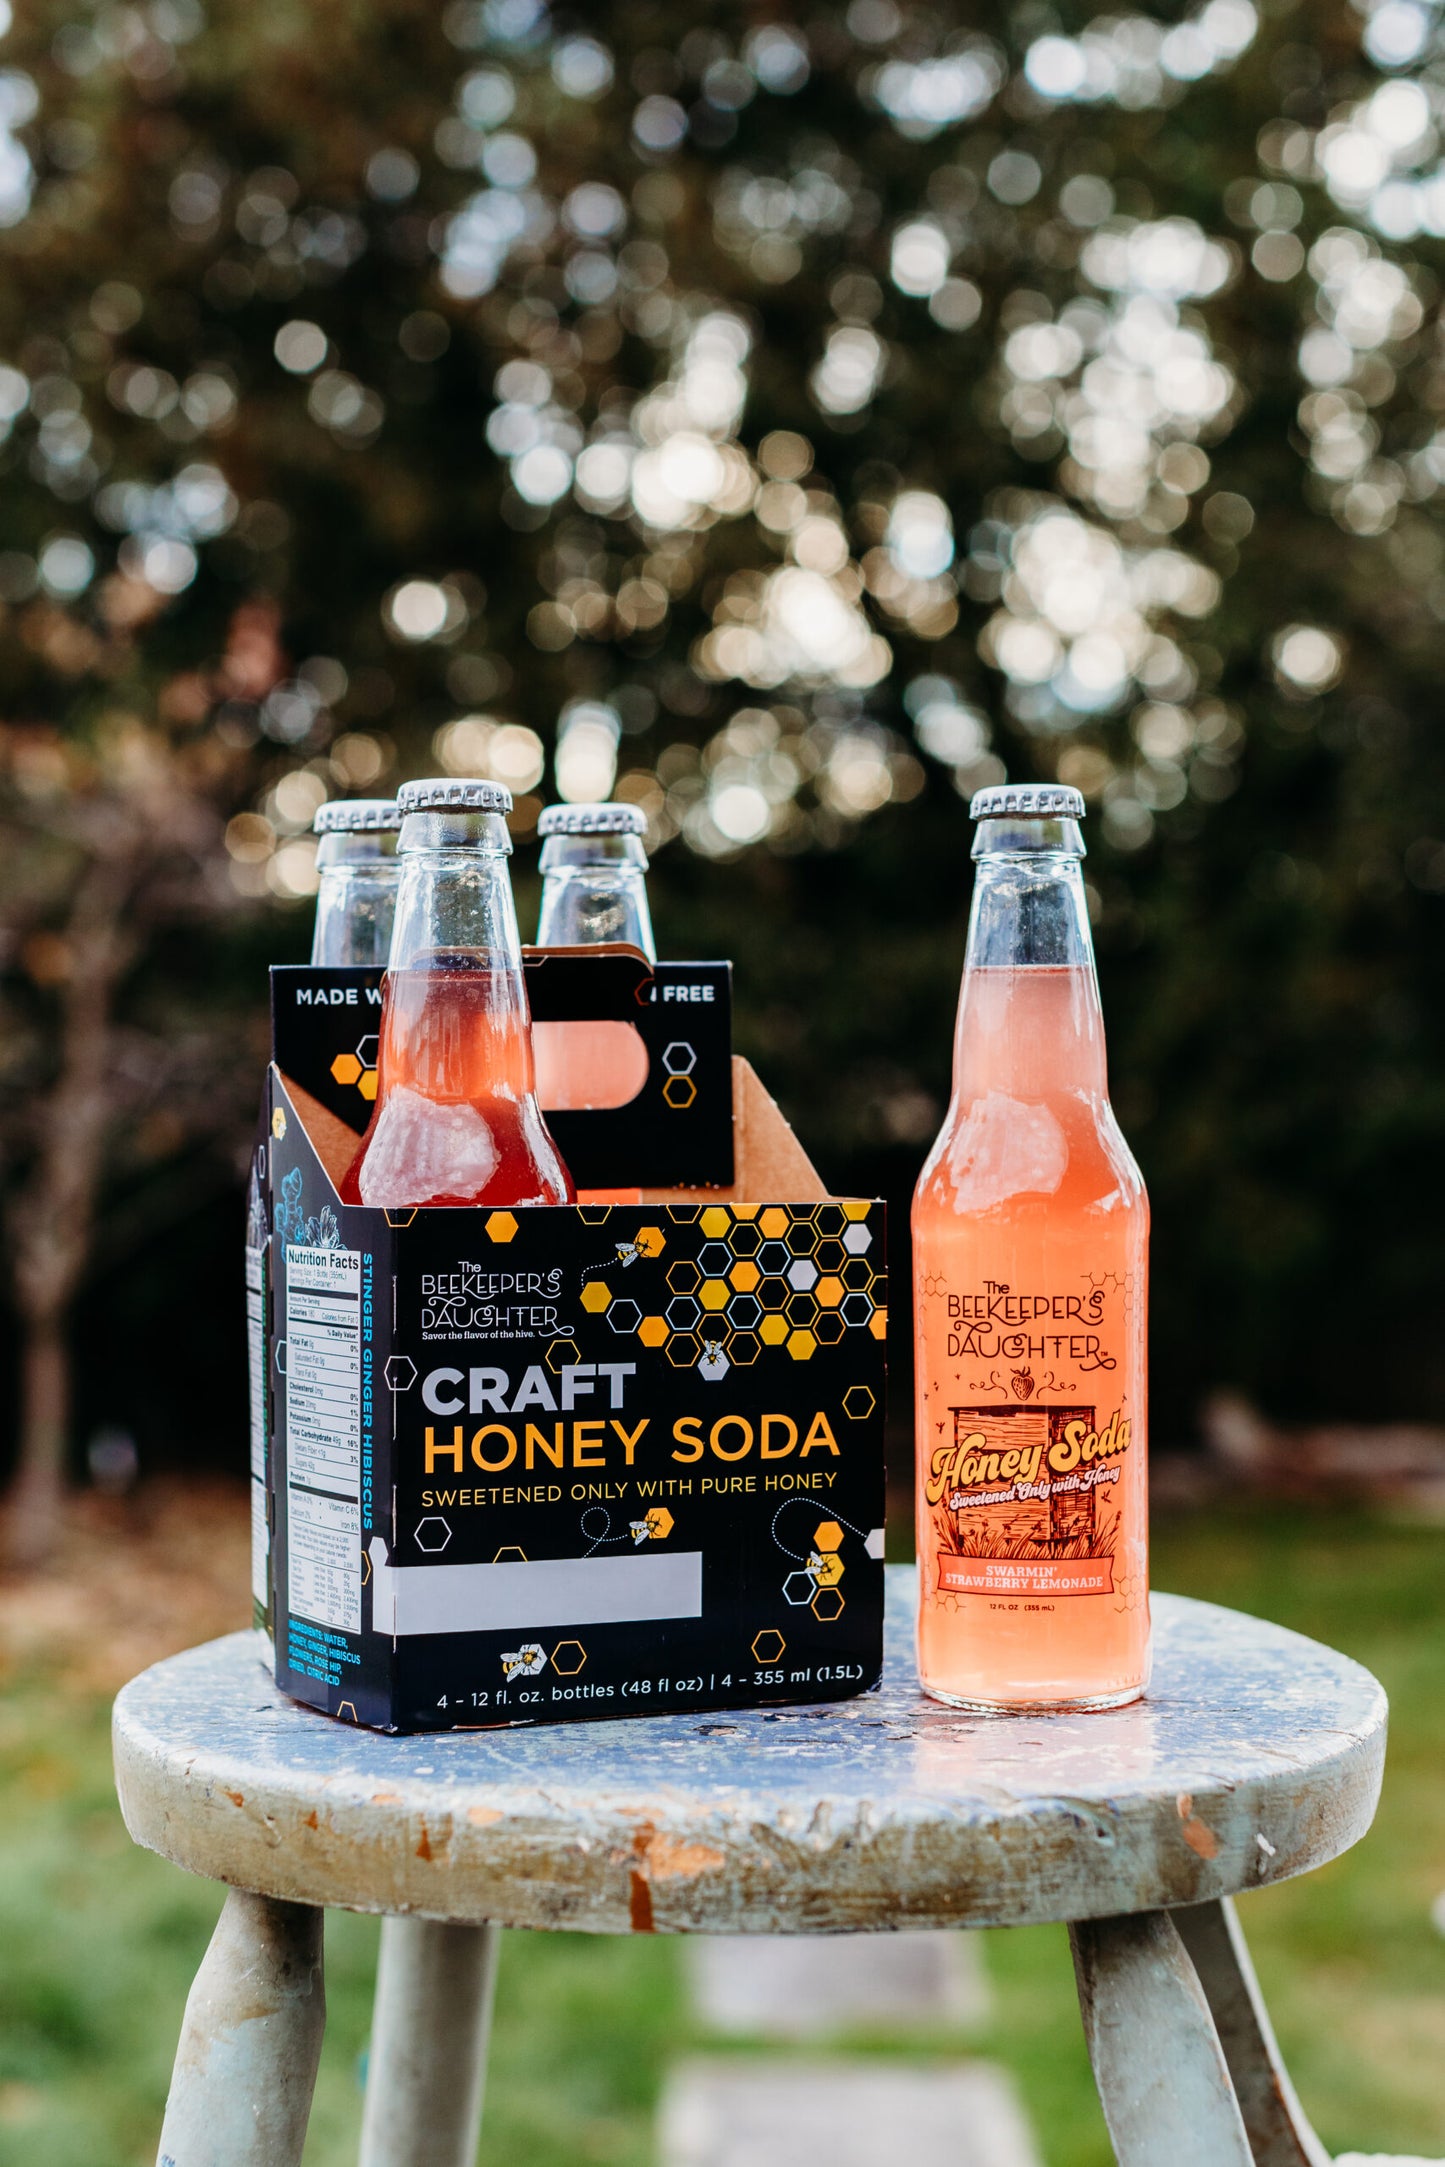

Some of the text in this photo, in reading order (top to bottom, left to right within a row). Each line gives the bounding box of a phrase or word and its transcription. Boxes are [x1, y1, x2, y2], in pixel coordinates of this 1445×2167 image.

[296, 988, 358, 1005] MADE
[663, 985, 715, 1002] FREE
[288, 1249, 359, 1270] Nutrition Facts
[458, 1261, 481, 1273] The
[421, 1268, 563, 1300] BEEKEEPER'S
[983, 1281, 1010, 1294] The
[290, 1306, 307, 1317] Calories
[421, 1296, 575, 1337] DAUGHTER
[948, 1290, 1105, 1326] BEEKEEPER'S
[332, 1329, 342, 1339] Daily
[422, 1329, 535, 1340] Savor the flavor of the hive.
[290, 1336, 300, 1345] Total
[350, 1345, 358, 1353] 0%
[947, 1320, 1117, 1371] DAUGHTER
[290, 1382, 314, 1393] Cholesterol
[363, 1253, 373, 1529] STINGER GINGER HIBISCUS
[421, 1362, 636, 1416] CRAFT
[290, 1397, 305, 1406] Sodium
[350, 1409, 358, 1417] 1%
[290, 1426, 300, 1435] Total
[301, 1429, 332, 1442] Carbohydrate
[350, 1425, 358, 1433] 0%
[424, 1411, 841, 1473] HONEY SODA
[350, 1456, 358, 1464] 3%
[925, 1408, 1132, 1506] Honey Soda
[290, 1471, 305, 1481] Protein
[421, 1472, 838, 1507] SWEETENED ONLY WITH PURE HONEY
[950, 1463, 1121, 1512] Sweetened Only with Honey
[346, 1505, 350, 1514] C
[985, 1565, 1057, 1577] SWARMIN'
[945, 1573, 1103, 1589] STRAWBERRY LEMONADE
[1024, 1604, 1040, 1612] (355
[324, 1632, 348, 1650] WATER,
[329, 1648, 360, 1665] HIBISCUS
[329, 1661, 342, 1675] HIP,
[324, 1673, 340, 1686] ACID
[436, 1695, 448, 1709] 4
[471, 1692, 489, 1706] 12
[496, 1690, 512, 1704] fl.
[519, 1691, 544, 1703] oz.
[552, 1684, 615, 1700] bottles
[621, 1680, 651, 1697] (48
[658, 1678, 669, 1692] fl
[675, 1676, 704, 1692] oz)
[721, 1673, 732, 1687] 4
[753, 1670, 785, 1685] 355
[790, 1668, 810, 1682] ml
[816, 1664, 864, 1682] (1.5L)
